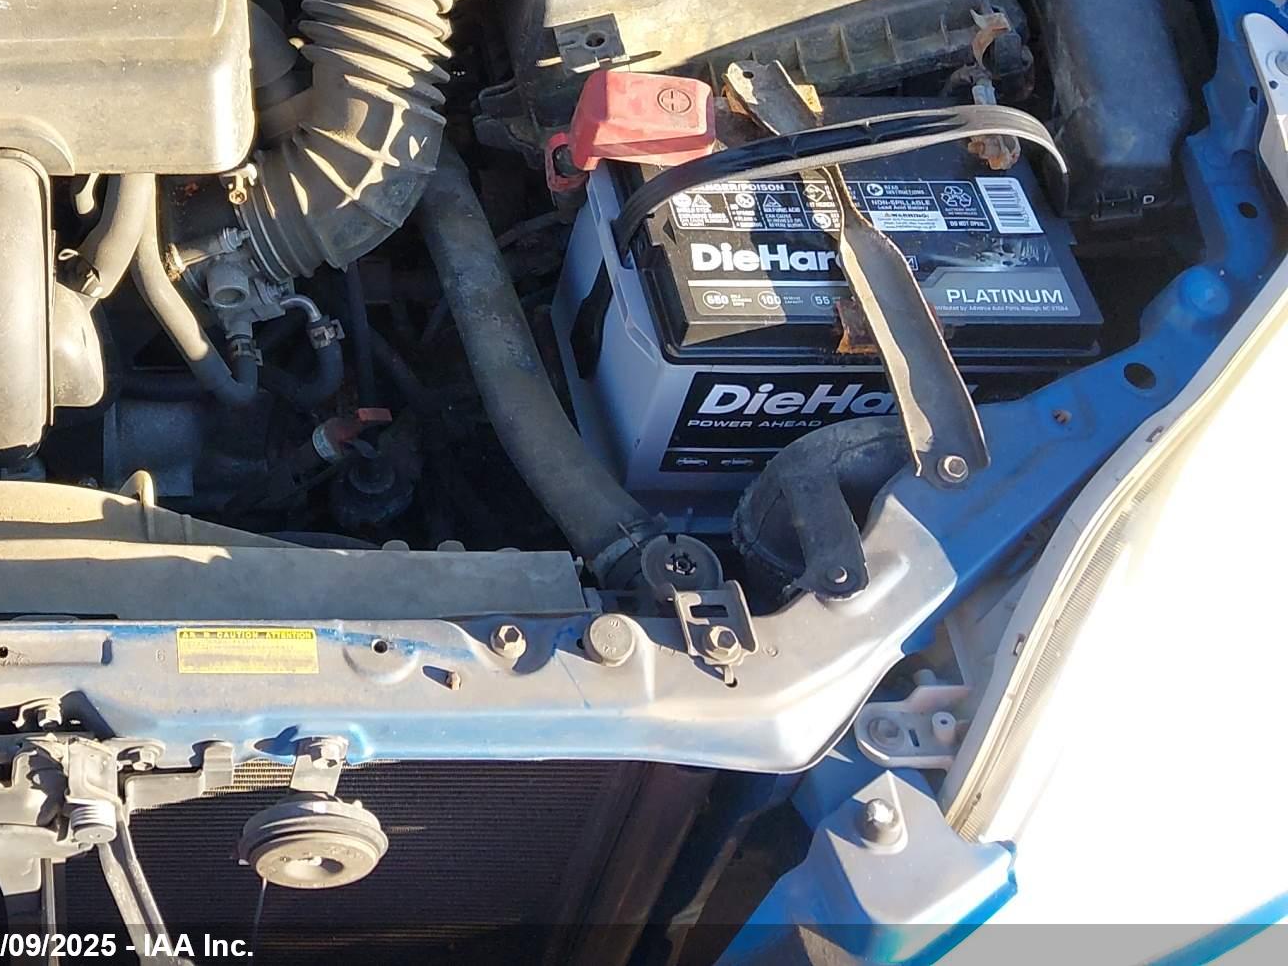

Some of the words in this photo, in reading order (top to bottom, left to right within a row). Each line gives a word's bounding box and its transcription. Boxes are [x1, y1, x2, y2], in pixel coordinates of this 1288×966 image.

[691, 243, 841, 272] DieHar
[946, 289, 1063, 303] PLATINUM
[698, 383, 898, 414] DieHa
[687, 420, 753, 428] POWER
[758, 420, 822, 428] AHEAD
[216, 631, 258, 639] CAUTION
